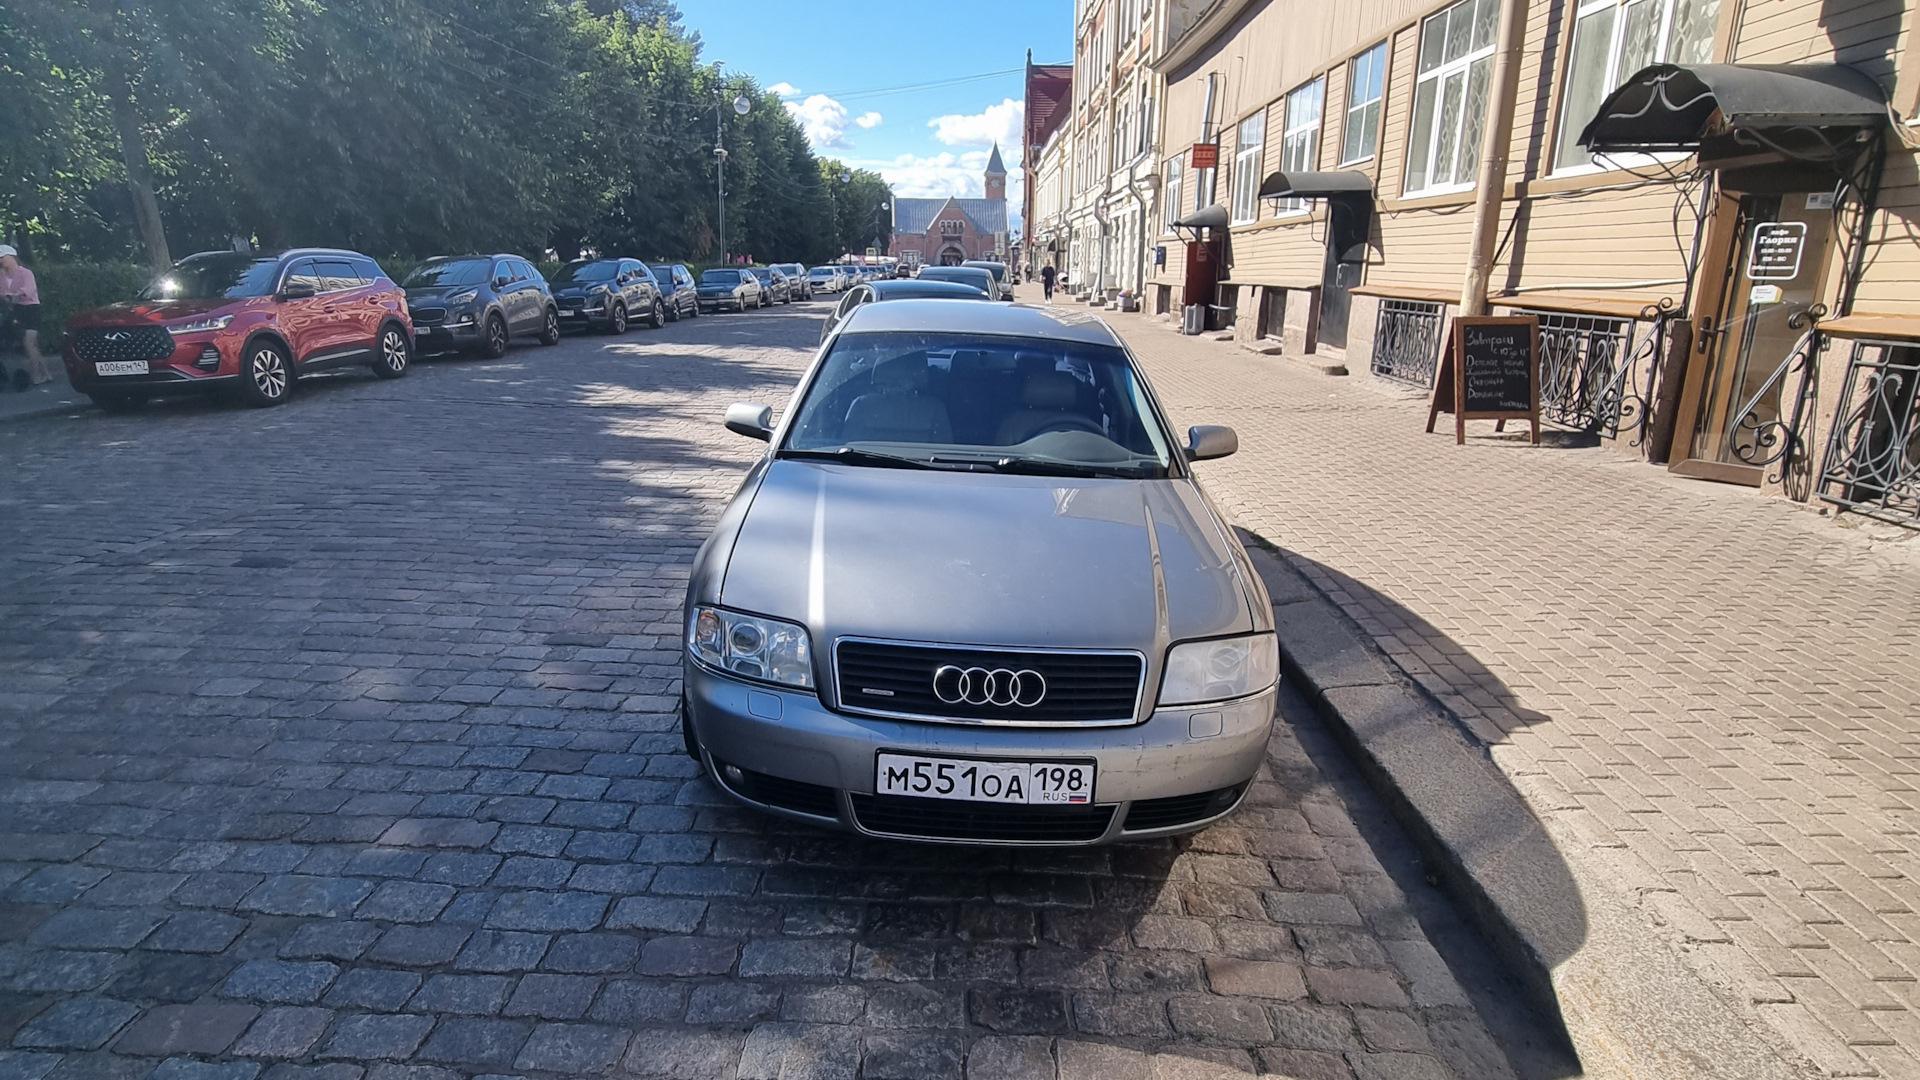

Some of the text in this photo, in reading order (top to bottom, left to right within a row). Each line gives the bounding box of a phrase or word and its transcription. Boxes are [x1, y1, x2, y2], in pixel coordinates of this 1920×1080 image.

[887, 761, 1083, 799] М551ОА 198
[1043, 792, 1068, 802] RUS
